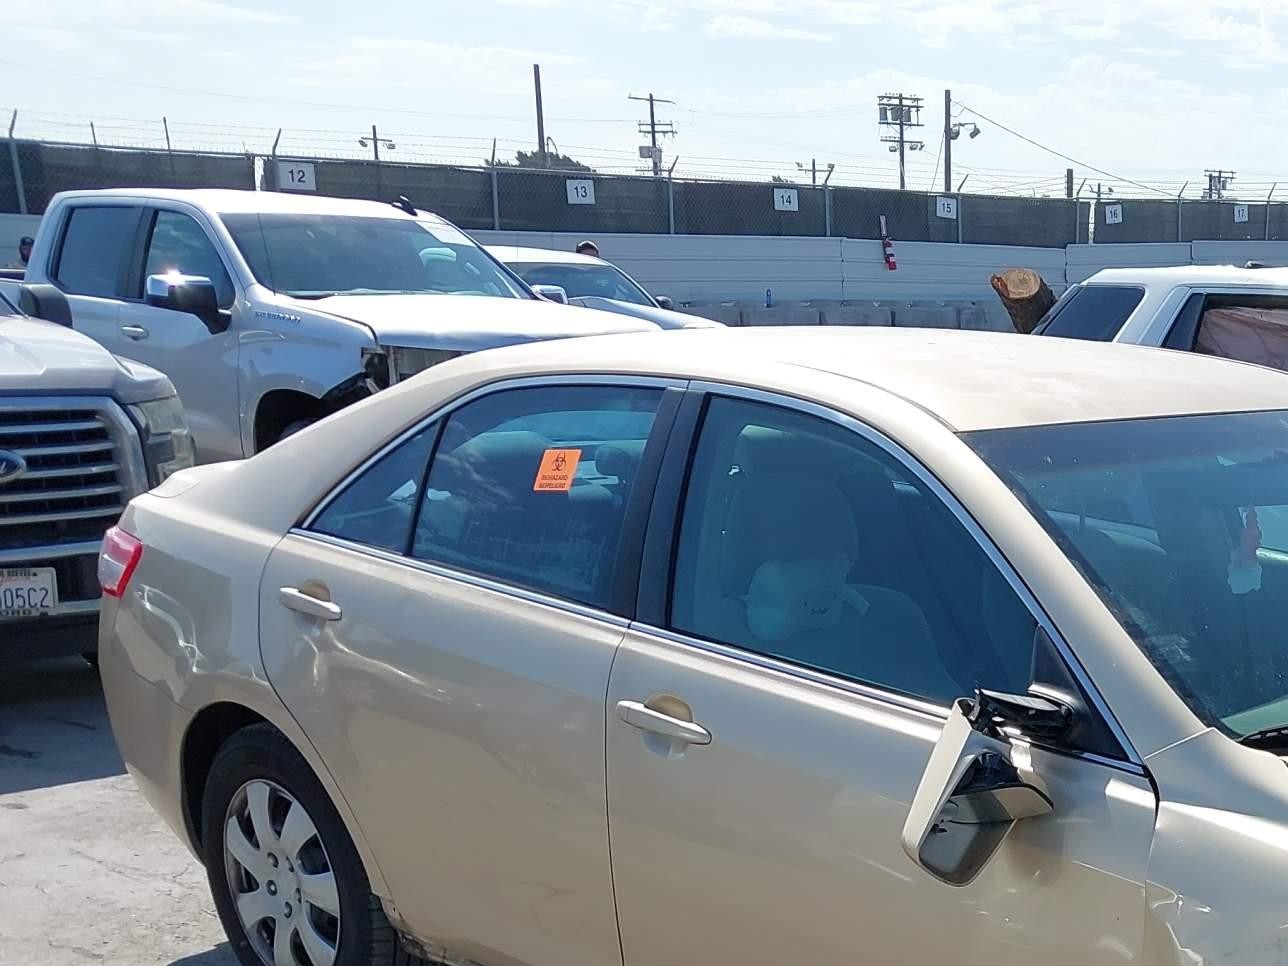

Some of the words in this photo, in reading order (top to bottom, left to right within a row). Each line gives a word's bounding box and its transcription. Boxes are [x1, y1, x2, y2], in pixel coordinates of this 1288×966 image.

[288, 168, 306, 183] 12
[574, 185, 588, 198] 13
[780, 194, 792, 206] 14
[942, 202, 952, 214] 15
[1109, 209, 1118, 219] 16
[1238, 208, 1245, 218] 17
[0, 587, 49, 609] 05C2
